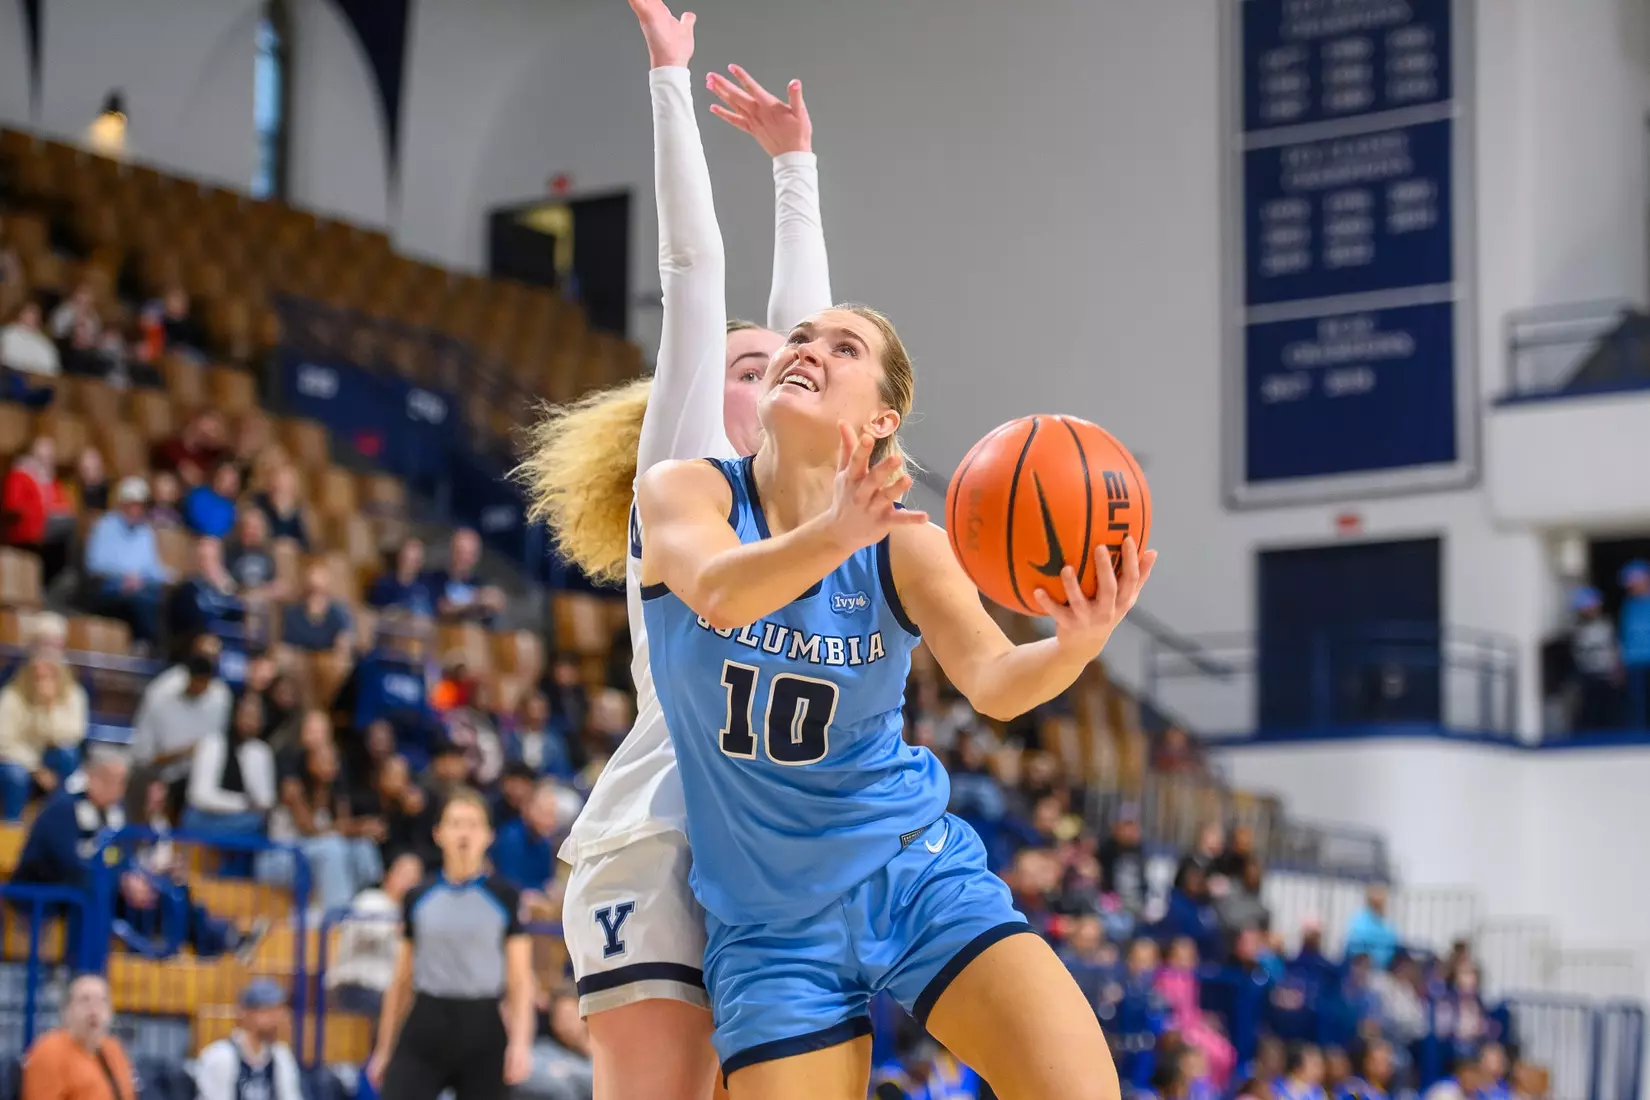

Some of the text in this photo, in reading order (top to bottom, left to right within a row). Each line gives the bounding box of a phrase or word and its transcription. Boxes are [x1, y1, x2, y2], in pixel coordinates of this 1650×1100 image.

[834, 596, 856, 610] Ivy
[718, 658, 840, 767] 10
[594, 900, 636, 959] Y
